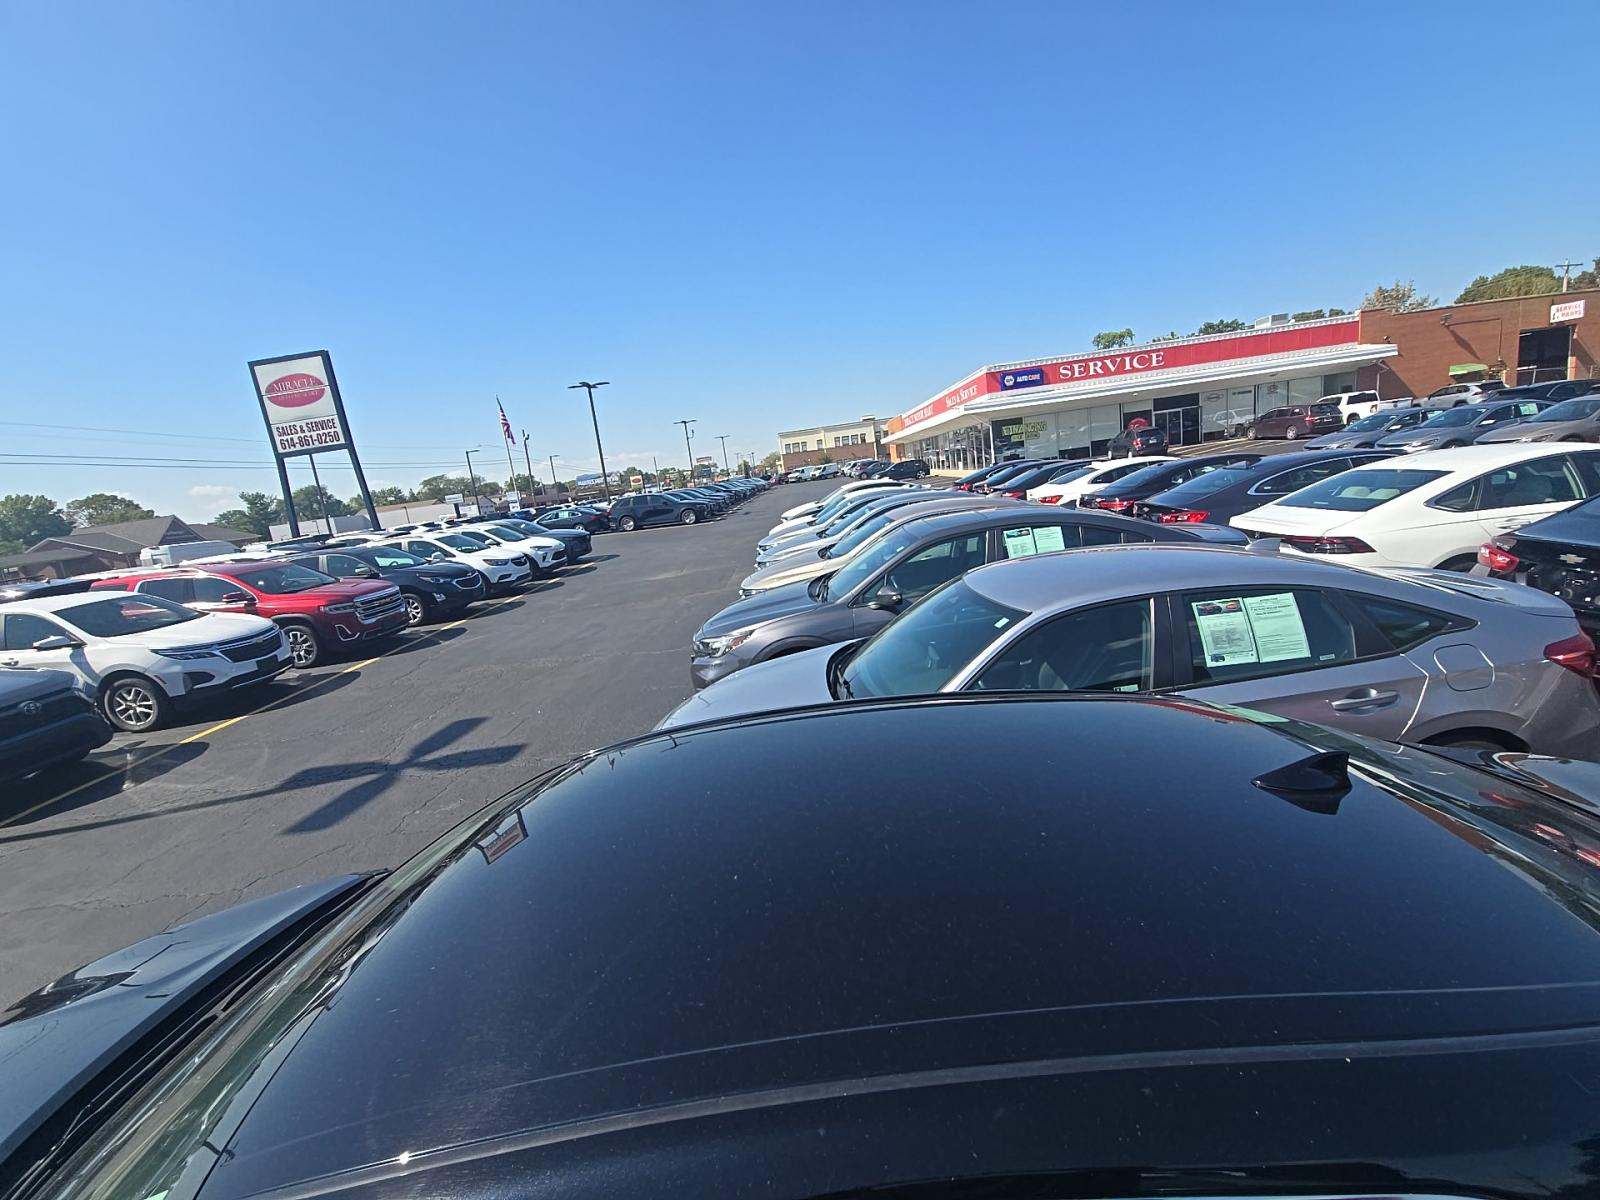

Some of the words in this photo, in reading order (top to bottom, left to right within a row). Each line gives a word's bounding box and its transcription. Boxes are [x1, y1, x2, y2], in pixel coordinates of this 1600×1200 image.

[1060, 352, 1165, 379] SERVICE
[276, 424, 299, 437] SALES
[300, 424, 305, 434] &
[305, 418, 337, 433] SERVICE
[279, 430, 341, 450] 614-861-0250
